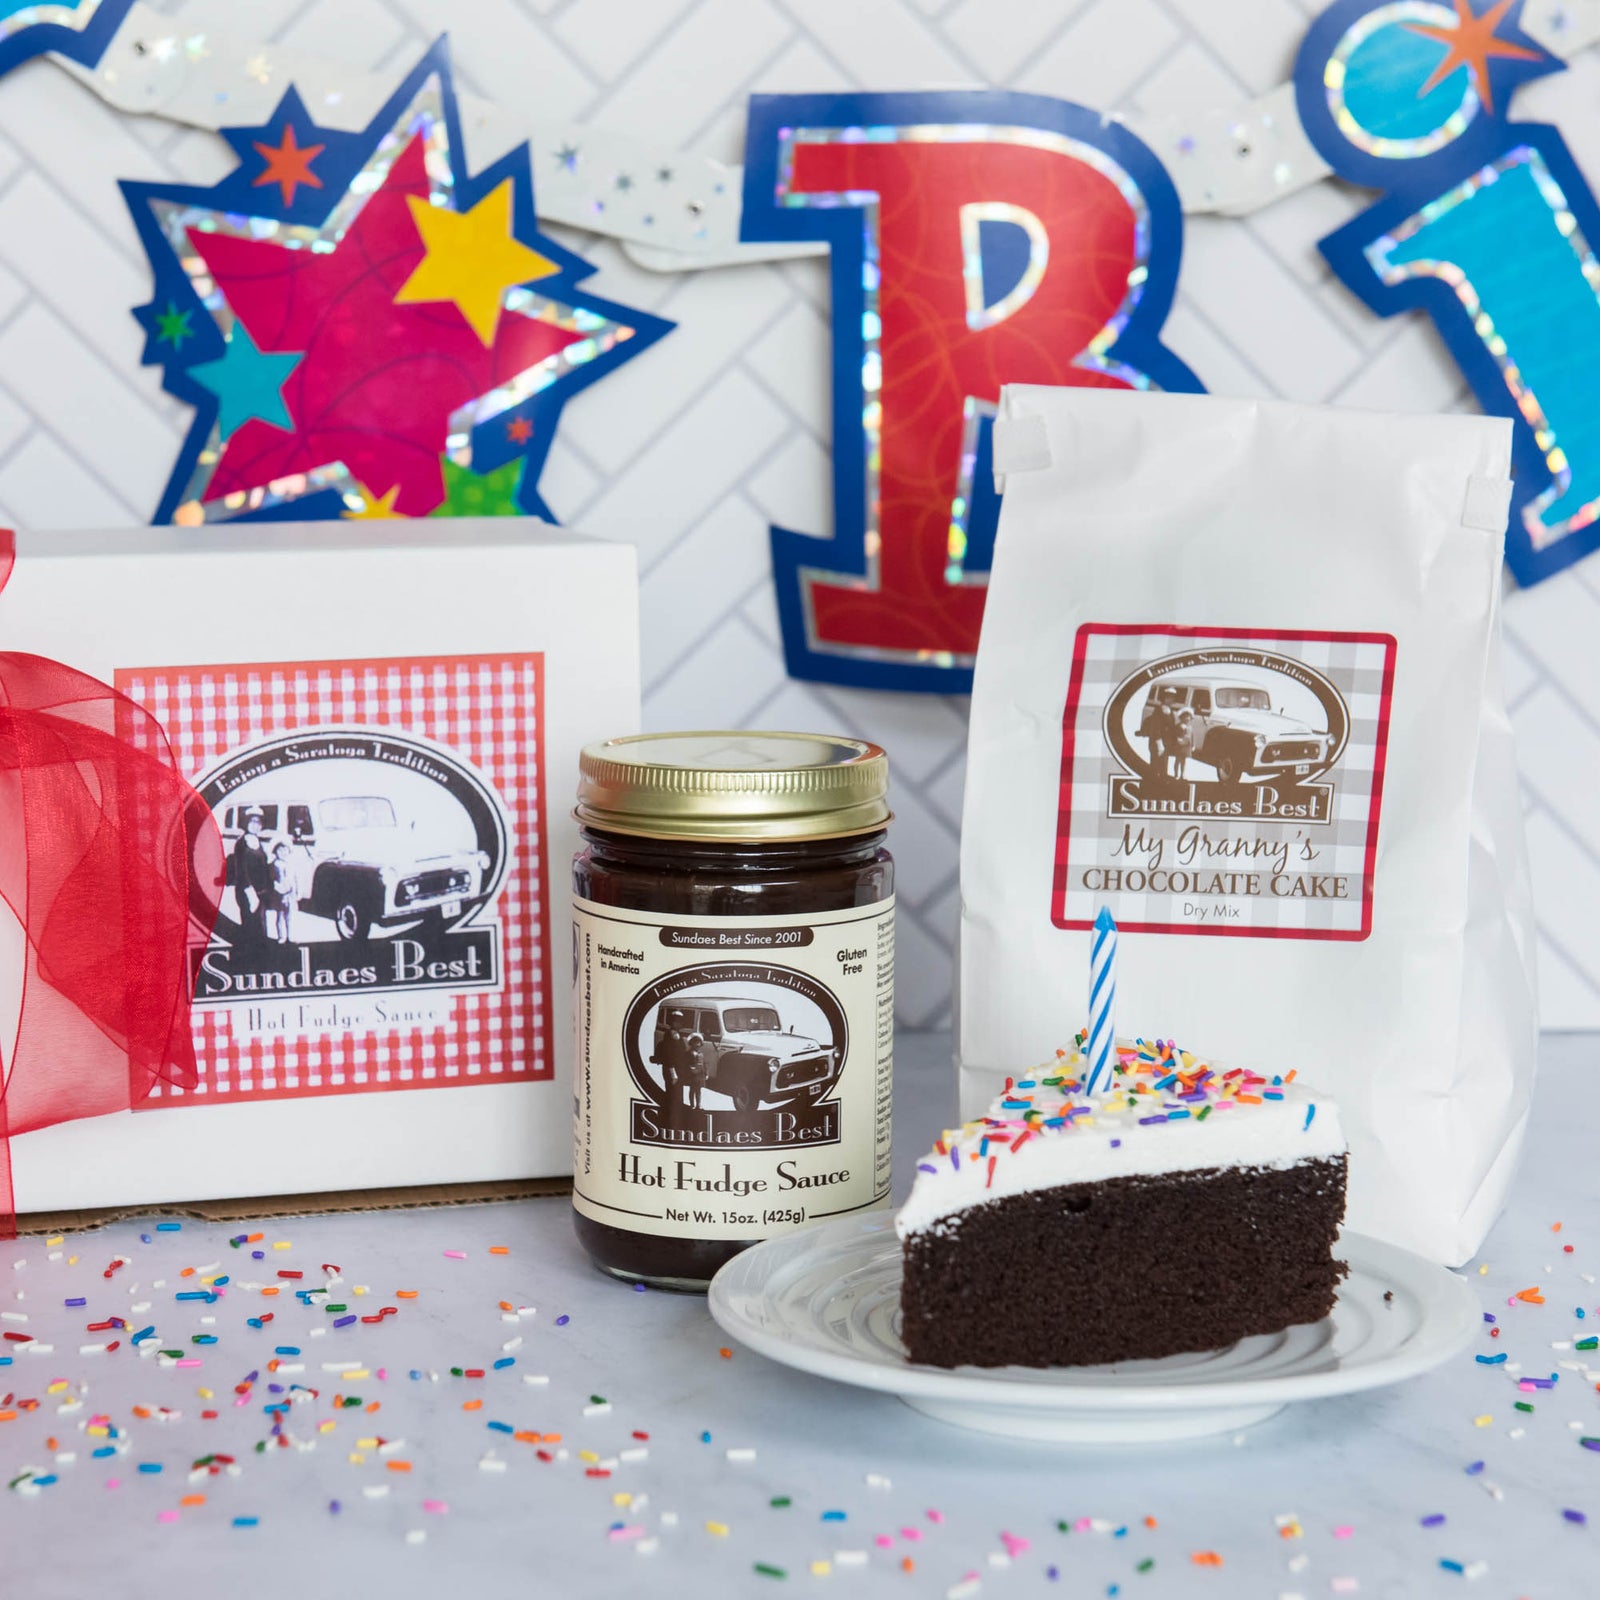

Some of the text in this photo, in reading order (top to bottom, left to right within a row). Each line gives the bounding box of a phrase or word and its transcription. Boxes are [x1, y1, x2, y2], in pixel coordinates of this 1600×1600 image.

[1146, 662, 1184, 678] Enjoy
[1198, 652, 1255, 664] Saratoga
[1261, 655, 1313, 686] Tradition
[215, 742, 449, 794] Enjoy a Saratoga Tradition
[1119, 781, 1321, 818] Sundaes Best
[1110, 824, 1321, 876] My Granny's
[1081, 868, 1350, 899] CHOCOLATE CAKE
[1183, 902, 1240, 920] Dry Mix
[597, 943, 644, 961] Handcrafted
[671, 931, 802, 945] Sundaes Best Since 2001
[201, 938, 482, 994] Sundaes Best
[600, 958, 640, 975] in America
[836, 948, 868, 962] Gluten
[842, 963, 863, 976] Free
[653, 980, 688, 998] Enjoy
[701, 969, 760, 980] Saratoga
[766, 970, 817, 997] Tradition
[249, 1000, 437, 1031] Hot Fudge Sauce
[584, 932, 592, 1110] www.sundaesbest.com
[586, 1113, 591, 1128] at
[641, 1108, 833, 1144] Sundaes Best
[586, 1131, 591, 1145] us
[618, 1152, 666, 1189] Hot
[673, 1161, 768, 1197] Fudge
[776, 1160, 851, 1193] Sauce
[666, 1207, 806, 1225] Net Wt. 15oz. (425g)
